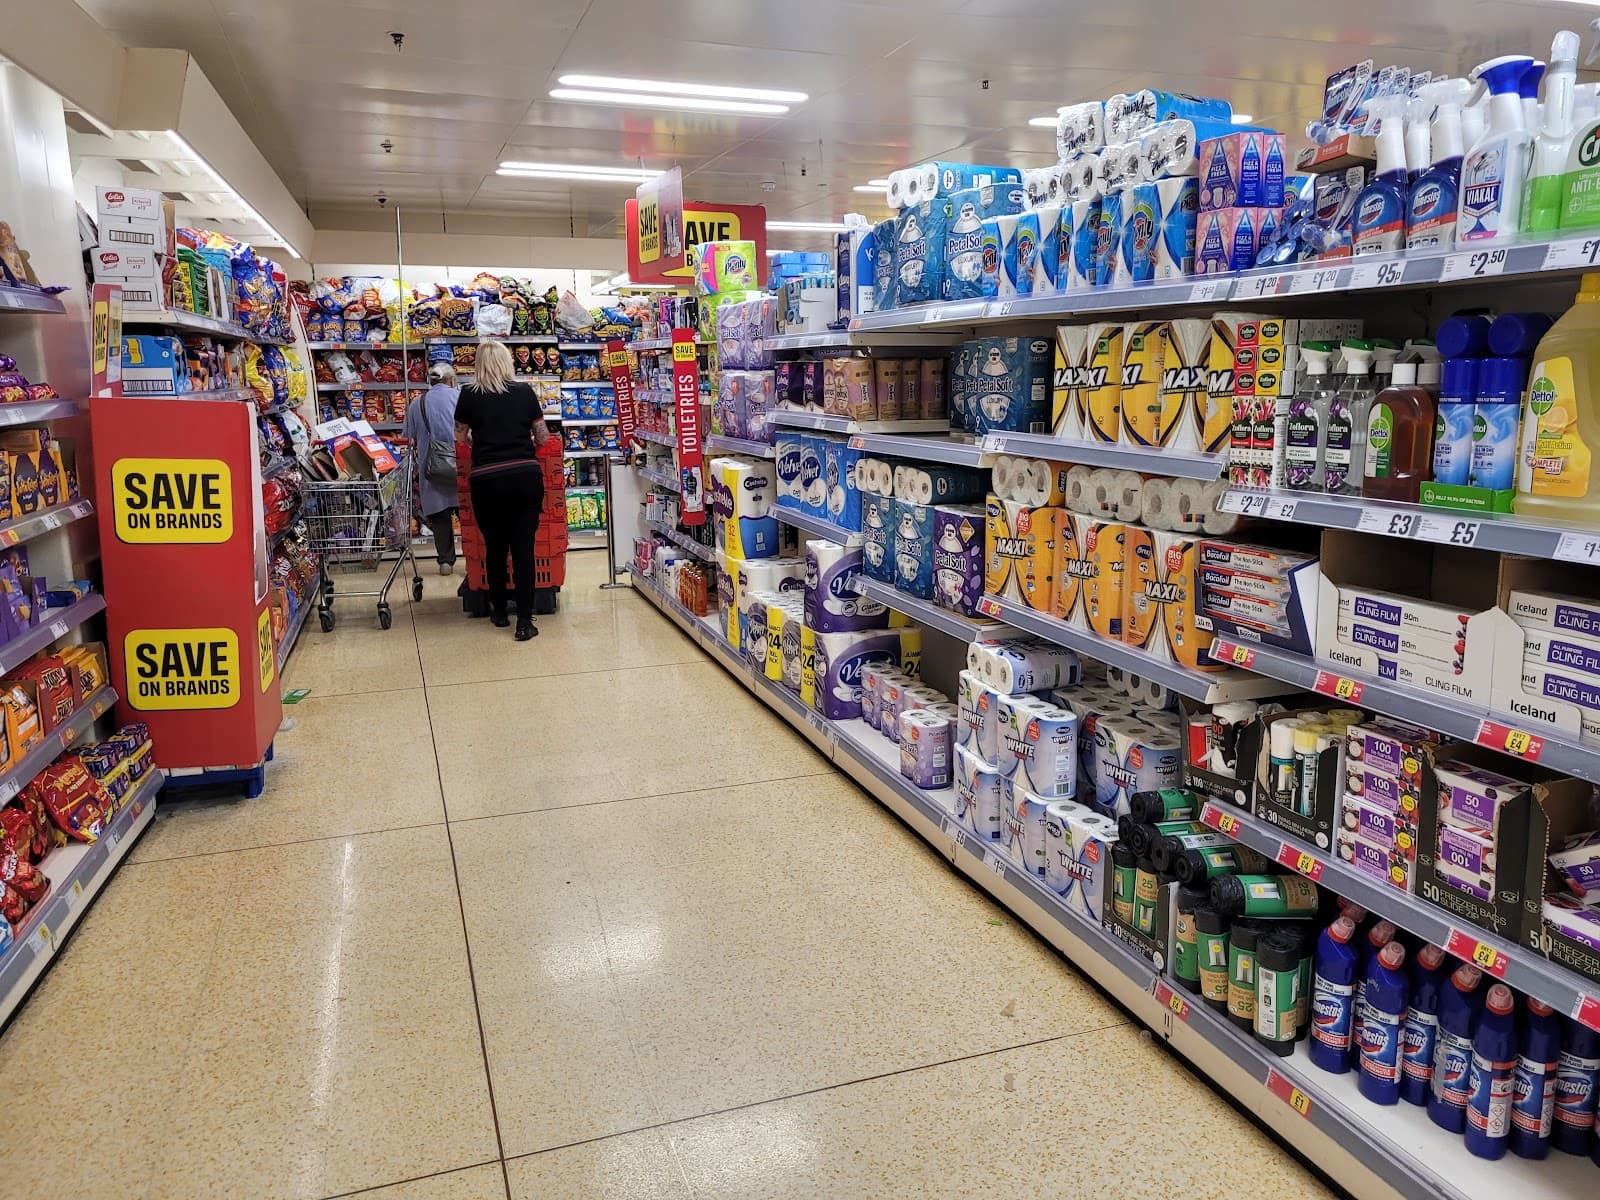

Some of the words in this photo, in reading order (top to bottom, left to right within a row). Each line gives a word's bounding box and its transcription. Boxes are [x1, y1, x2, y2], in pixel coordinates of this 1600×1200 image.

[1581, 135, 1600, 163] Ci
[106, 191, 124, 202] Lotus
[1416, 191, 1441, 205] Domestos
[1467, 186, 1495, 205] VIAKAL
[640, 202, 658, 236] SAVE
[685, 221, 730, 250] AVE
[949, 234, 981, 254] PetalSo
[102, 253, 118, 262] Lotus
[1470, 249, 1506, 276] £2.50
[1313, 270, 1335, 289] £1.20
[1377, 263, 1402, 285] 95p
[1256, 277, 1276, 295] £1.20
[611, 352, 625, 361] SAVE
[1087, 366, 1106, 386] XI
[1122, 364, 1142, 384] XI
[1163, 367, 1209, 389] MAX
[1531, 391, 1554, 402] Dettol
[616, 375, 635, 437] TOILETRIES
[679, 374, 697, 454] TOILETRIES
[1232, 424, 1252, 432] Zoflora
[1253, 425, 1274, 433] Zoflora
[1289, 422, 1315, 432] Zoflora
[1328, 423, 1348, 433] Zoflora
[1370, 429, 1390, 439] Dettol
[779, 456, 800, 476] Velve
[124, 472, 222, 510] SAVE
[745, 477, 768, 490] Cushelle
[1241, 495, 1264, 513] £2.20
[1280, 504, 1294, 517] £2
[128, 513, 151, 529] ON
[156, 513, 223, 530] BRANDS
[1388, 513, 1412, 534] £3
[728, 523, 736, 537] 32
[1450, 522, 1477, 544] £5
[997, 538, 1026, 556] MAXI
[1167, 550, 1181, 560] BIG
[1206, 549, 1230, 562] Bacofoil
[1068, 560, 1093, 576] MAXI
[1205, 573, 1230, 585] Bacofoil
[1234, 578, 1242, 586] The
[1146, 581, 1178, 600] MAXI
[1207, 594, 1230, 606] Bacofoil
[1357, 606, 1379, 618] CLING
[1380, 610, 1399, 622] FILM
[1403, 612, 1419, 622] 90m
[1516, 602, 1548, 616] Iceland
[1130, 616, 1136, 626] 3
[1558, 614, 1590, 630] CLING
[768, 633, 782, 650] 24
[1239, 628, 1261, 641] Bacofoil
[1355, 633, 1377, 645] CLING
[1378, 638, 1396, 650] FILM
[1401, 640, 1416, 650] 90m
[136, 641, 230, 678] SAVE
[802, 653, 815, 671] 24
[1236, 652, 1244, 661] £4
[1329, 649, 1362, 667] Iceland
[1551, 650, 1583, 666] CLING
[905, 661, 920, 678] 24
[1380, 664, 1396, 677] ILM
[138, 681, 161, 697] ON
[165, 679, 230, 697] BRANDS
[1341, 685, 1349, 695] £4
[1425, 676, 1450, 691] CLING
[1451, 683, 1472, 698] FILM
[1547, 683, 1578, 699] CLING
[1510, 700, 1556, 723] Iceland
[963, 712, 985, 728] WHITE
[1053, 735, 1073, 743] WHITE
[1510, 739, 1522, 750] £4
[1007, 738, 1035, 757] WHITE
[1374, 741, 1391, 755] 100
[1105, 764, 1137, 786] WHITE
[1156, 765, 1179, 774] WHITE
[1373, 777, 1390, 791] 100
[1465, 795, 1479, 808] 50
[1222, 818, 1229, 827] £4
[1268, 810, 1278, 824] 30
[1368, 813, 1385, 828] 100
[956, 832, 965, 846] £6
[1363, 847, 1379, 861] 100
[1451, 852, 1470, 867] 100
[1061, 855, 1093, 880] WHITE
[1300, 858, 1309, 868] £4
[1580, 866, 1594, 876] 50
[1142, 880, 1153, 889] 25
[1424, 881, 1440, 902] 50
[1439, 889, 1480, 912] FREEZER
[1479, 908, 1508, 926] BAGS
[1439, 897, 1464, 917] SLIDE
[1465, 909, 1480, 921] ZIP
[1113, 923, 1122, 938] 30
[1478, 951, 1489, 963] £4
[1552, 950, 1581, 969] SLIDE
[1553, 939, 1600, 967] FREEZER
[1314, 1002, 1344, 1018] mestos
[1445, 1060, 1467, 1073] stos
[1557, 1078, 1592, 1095] mestos
[1295, 1097, 1304, 1109] £1
